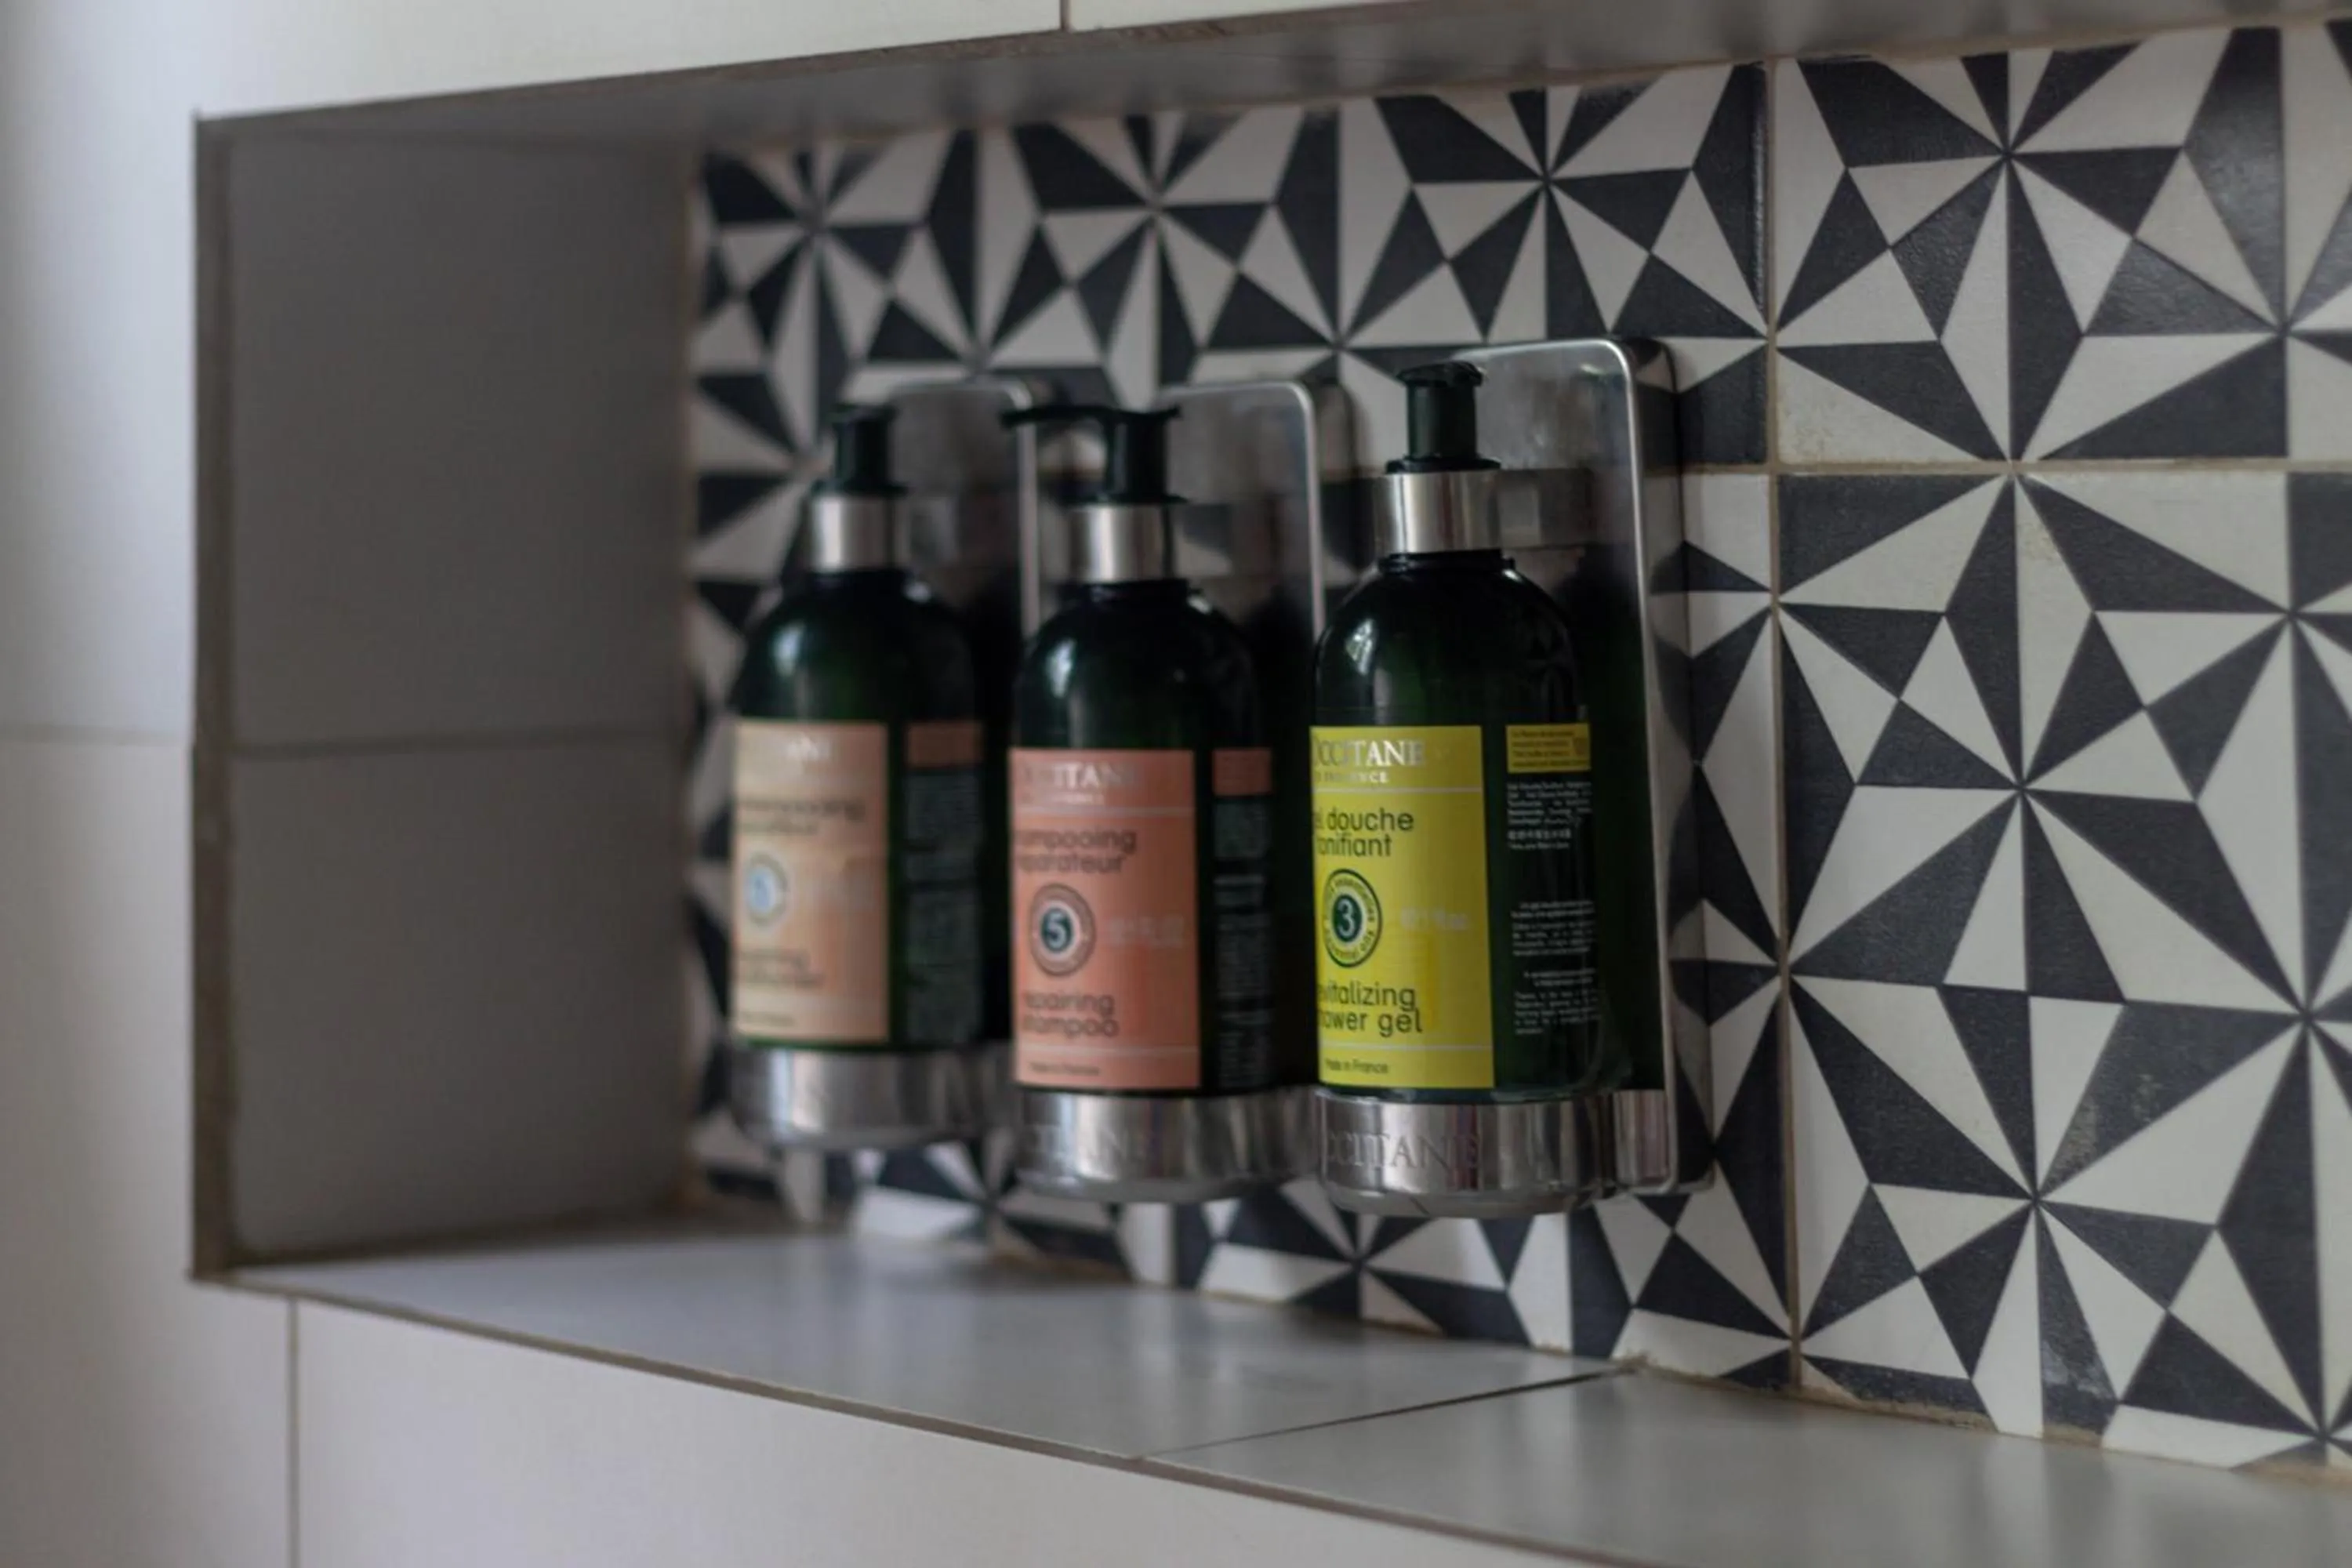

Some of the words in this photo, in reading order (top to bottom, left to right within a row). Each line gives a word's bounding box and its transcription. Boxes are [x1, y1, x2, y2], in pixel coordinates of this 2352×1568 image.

[1327, 807, 1414, 831] douche
[1047, 913, 1066, 949] 5
[1337, 898, 1355, 937] 3
[1319, 979, 1417, 1012] evitalizing
[1319, 1010, 1368, 1032] ower
[1377, 1007, 1424, 1039] gel
